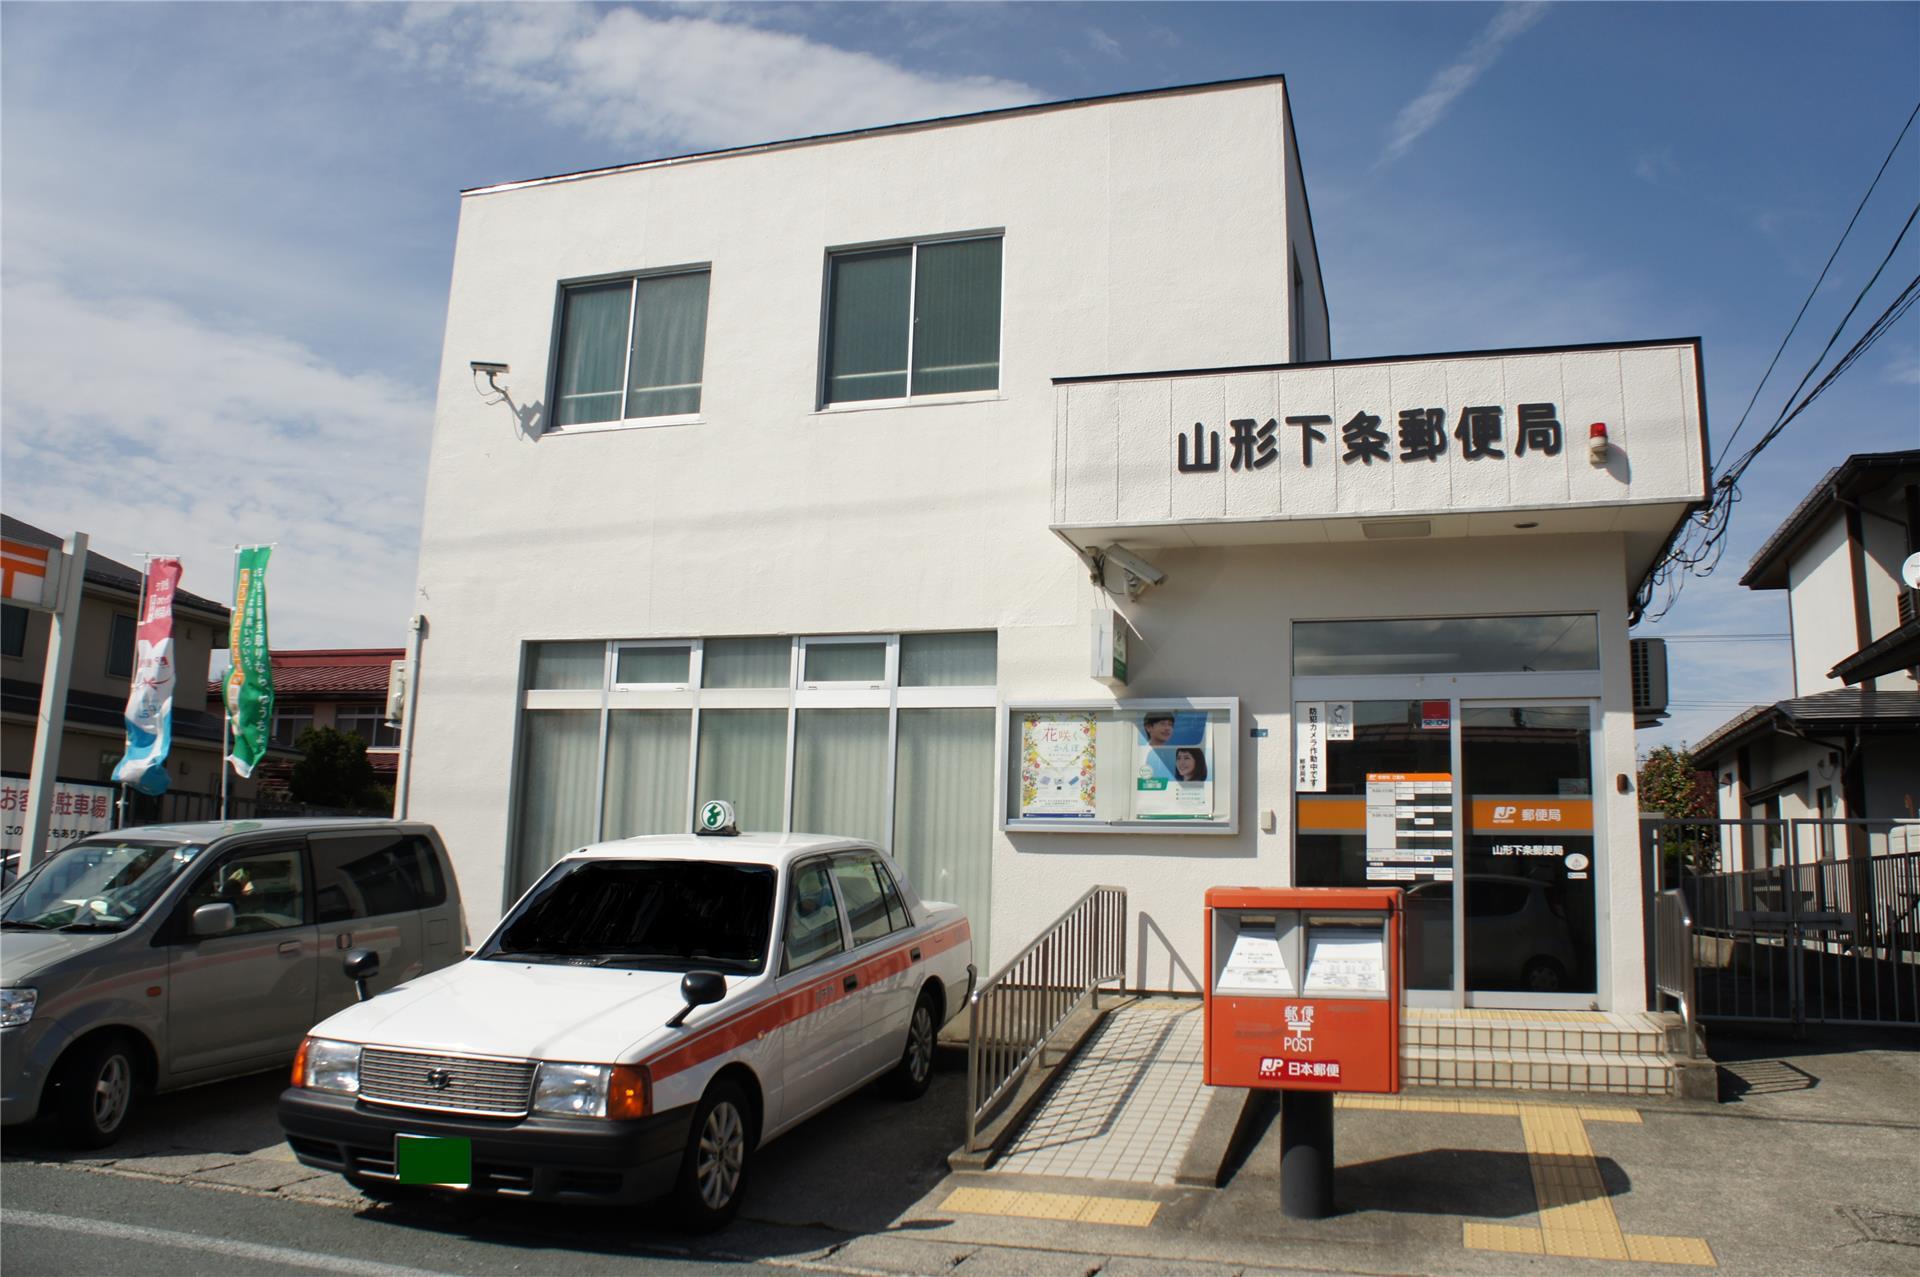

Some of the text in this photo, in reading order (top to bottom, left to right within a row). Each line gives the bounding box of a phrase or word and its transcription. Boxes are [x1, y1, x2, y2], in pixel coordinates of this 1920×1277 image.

[1178, 403, 1562, 472] 山形下条郵便局
[1309, 707, 1318, 787] 防犯カメラ作動中です
[1521, 808, 1561, 822] 郵便局
[1492, 845, 1564, 857] 山形下条郵便局
[1284, 1005, 1314, 1023] 郵便
[1284, 1037, 1314, 1053] POST
[1288, 1062, 1340, 1078] 日本郵便
